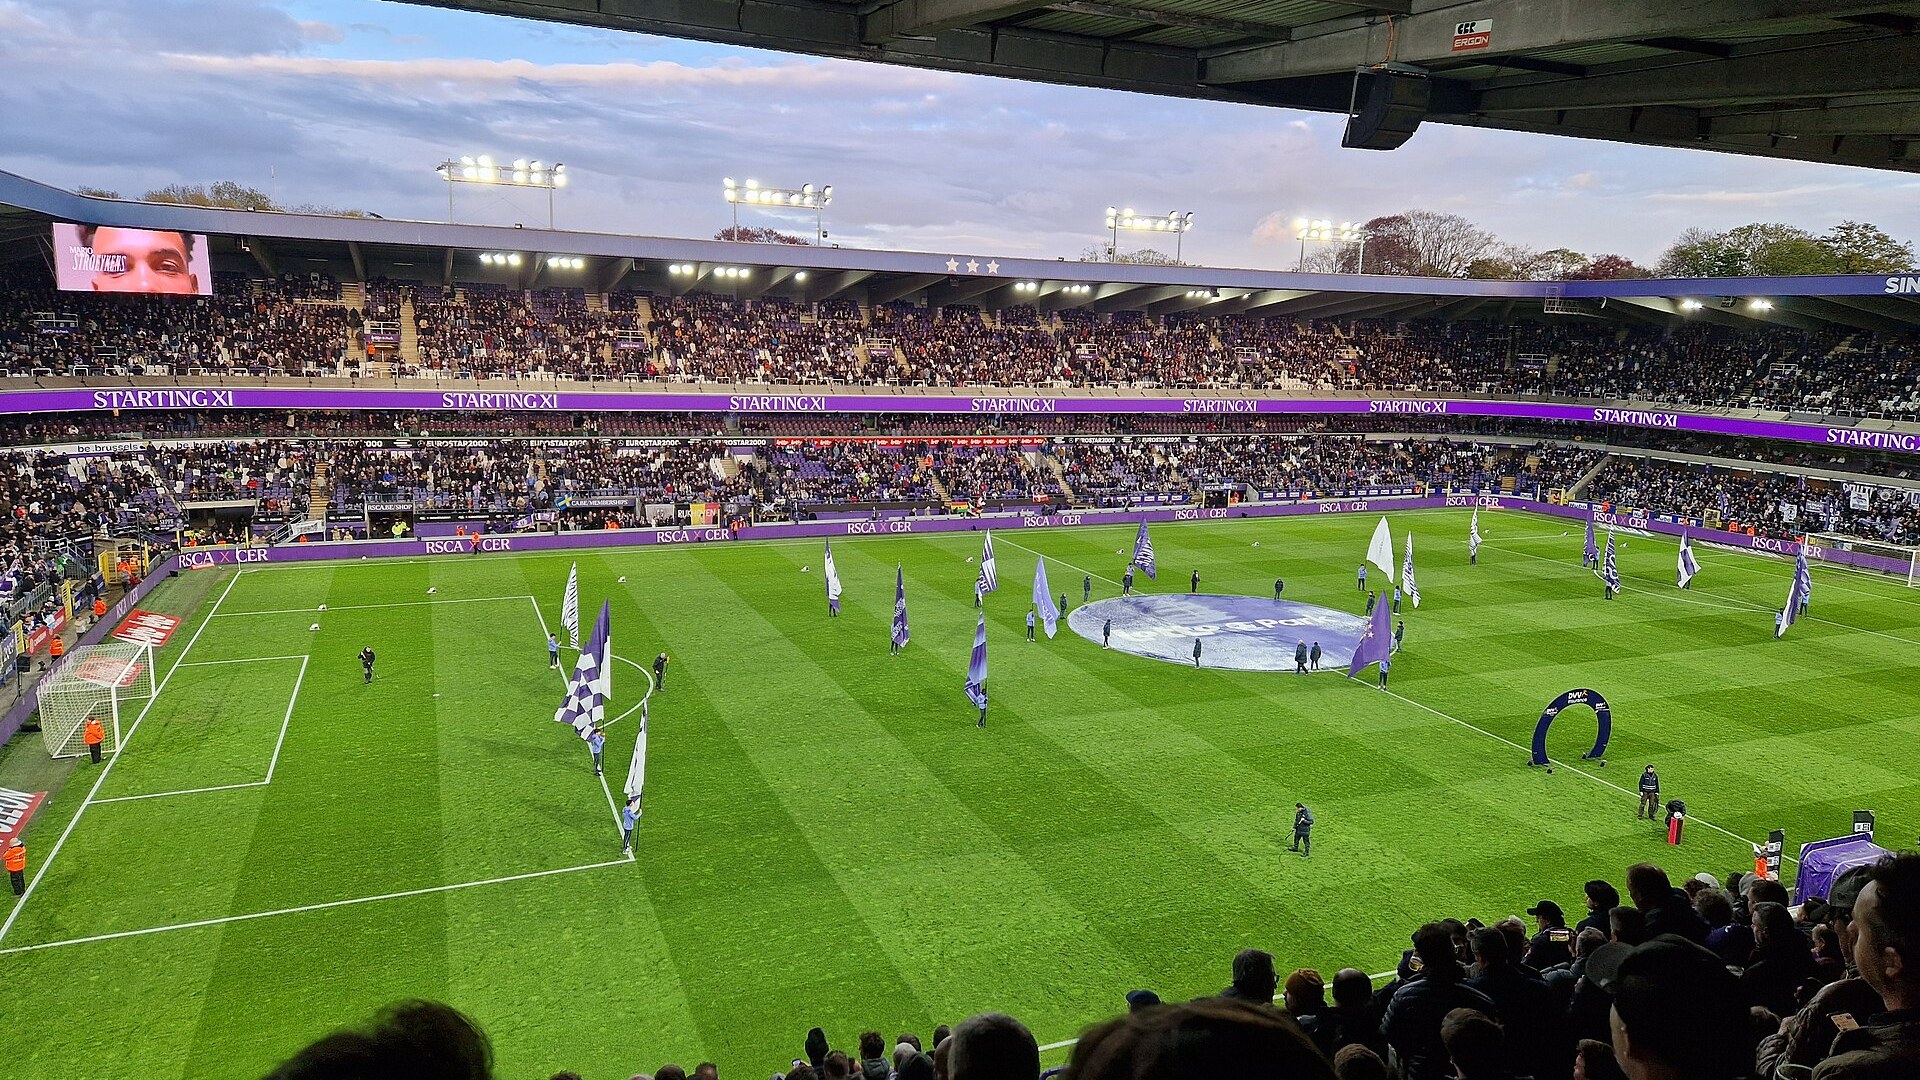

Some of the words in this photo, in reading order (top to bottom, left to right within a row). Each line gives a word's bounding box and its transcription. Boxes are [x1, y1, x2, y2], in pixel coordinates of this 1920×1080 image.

[1454, 36, 1489, 47] ERGON
[93, 390, 208, 408] STARTING
[211, 390, 234, 406] XI
[442, 393, 537, 408] STARTING
[539, 393, 558, 408] XI
[730, 396, 808, 410] STARTING
[810, 397, 825, 410] XI
[971, 398, 1041, 411] STARTING
[1042, 399, 1056, 411] XI
[1183, 400, 1244, 411] STARTING
[1244, 400, 1257, 411] XI
[1370, 401, 1431, 412] STARTING
[1432, 401, 1446, 412] XI
[1593, 408, 1662, 426] STARTING
[1662, 414, 1677, 427] XI
[1826, 428, 1915, 450] STARTING
[1319, 502, 1342, 512] RSCA
[1351, 501, 1368, 511] CER
[1445, 497, 1467, 506] RSCA
[1478, 497, 1499, 506] CER
[1023, 516, 1049, 527] RSCA
[1062, 514, 1081, 525] CER
[1174, 509, 1199, 519] RSCA
[1209, 508, 1228, 518] CER
[1593, 512, 1618, 525] RSCA
[1628, 516, 1649, 529] CER
[847, 522, 877, 533] RSCA
[889, 521, 912, 532] CER
[656, 531, 690, 543] RSCA
[705, 528, 730, 541] CER
[425, 541, 465, 553] RSCA
[482, 538, 511, 551] CER
[1751, 536, 1782, 552] RSCA
[1806, 545, 1822, 558] ER
[178, 551, 214, 569] RSCA
[235, 549, 268, 563] CER
